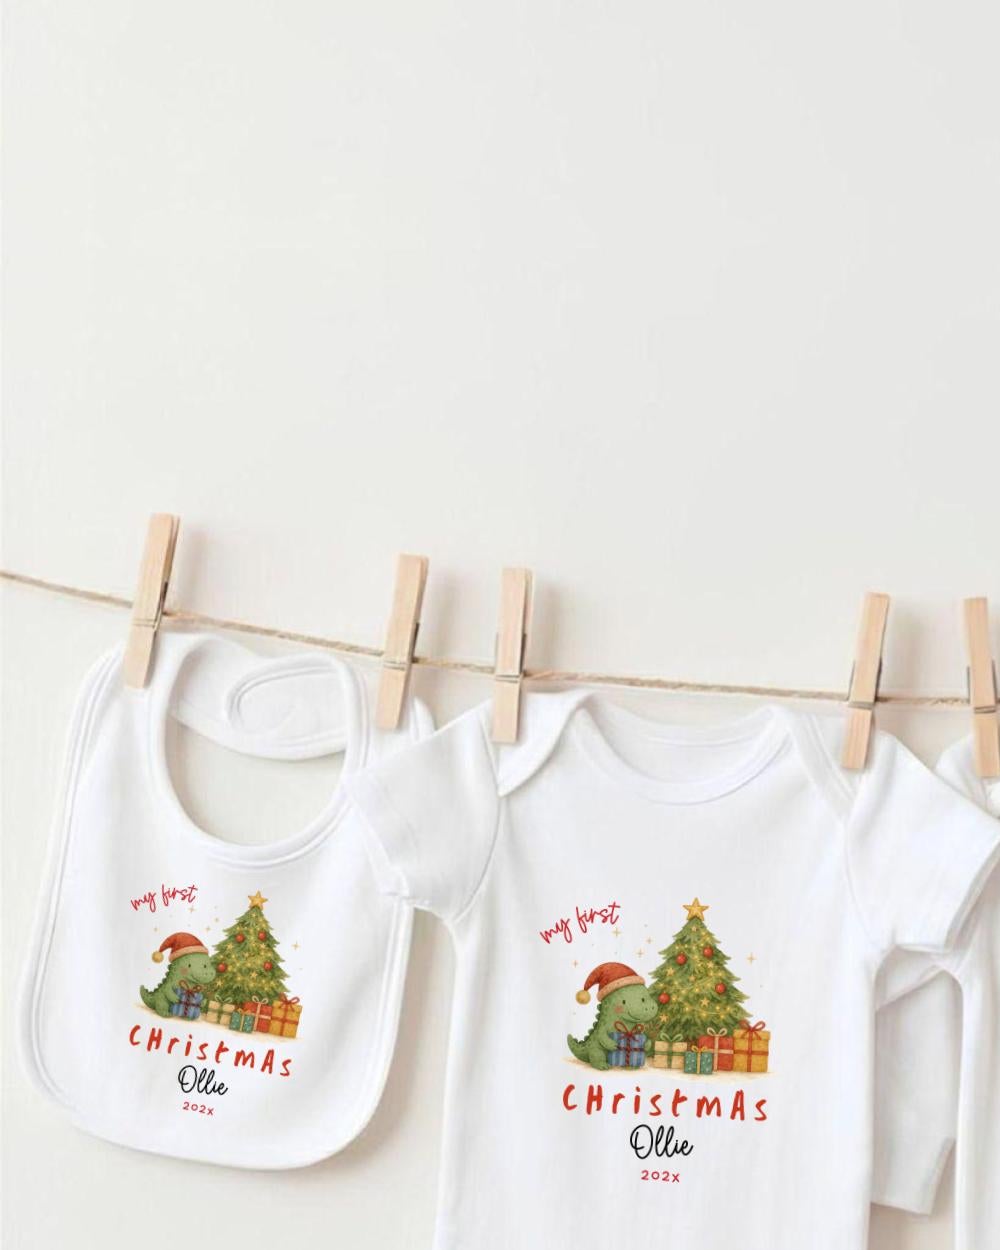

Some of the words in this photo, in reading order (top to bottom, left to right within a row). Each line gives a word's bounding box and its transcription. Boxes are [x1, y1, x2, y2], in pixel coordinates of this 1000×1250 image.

[129, 891, 157, 913] my
[161, 883, 198, 906] first
[539, 917, 573, 945] my
[575, 901, 621, 934] first
[177, 1064, 229, 1096] Ollie
[629, 1123, 694, 1160] Ollie
